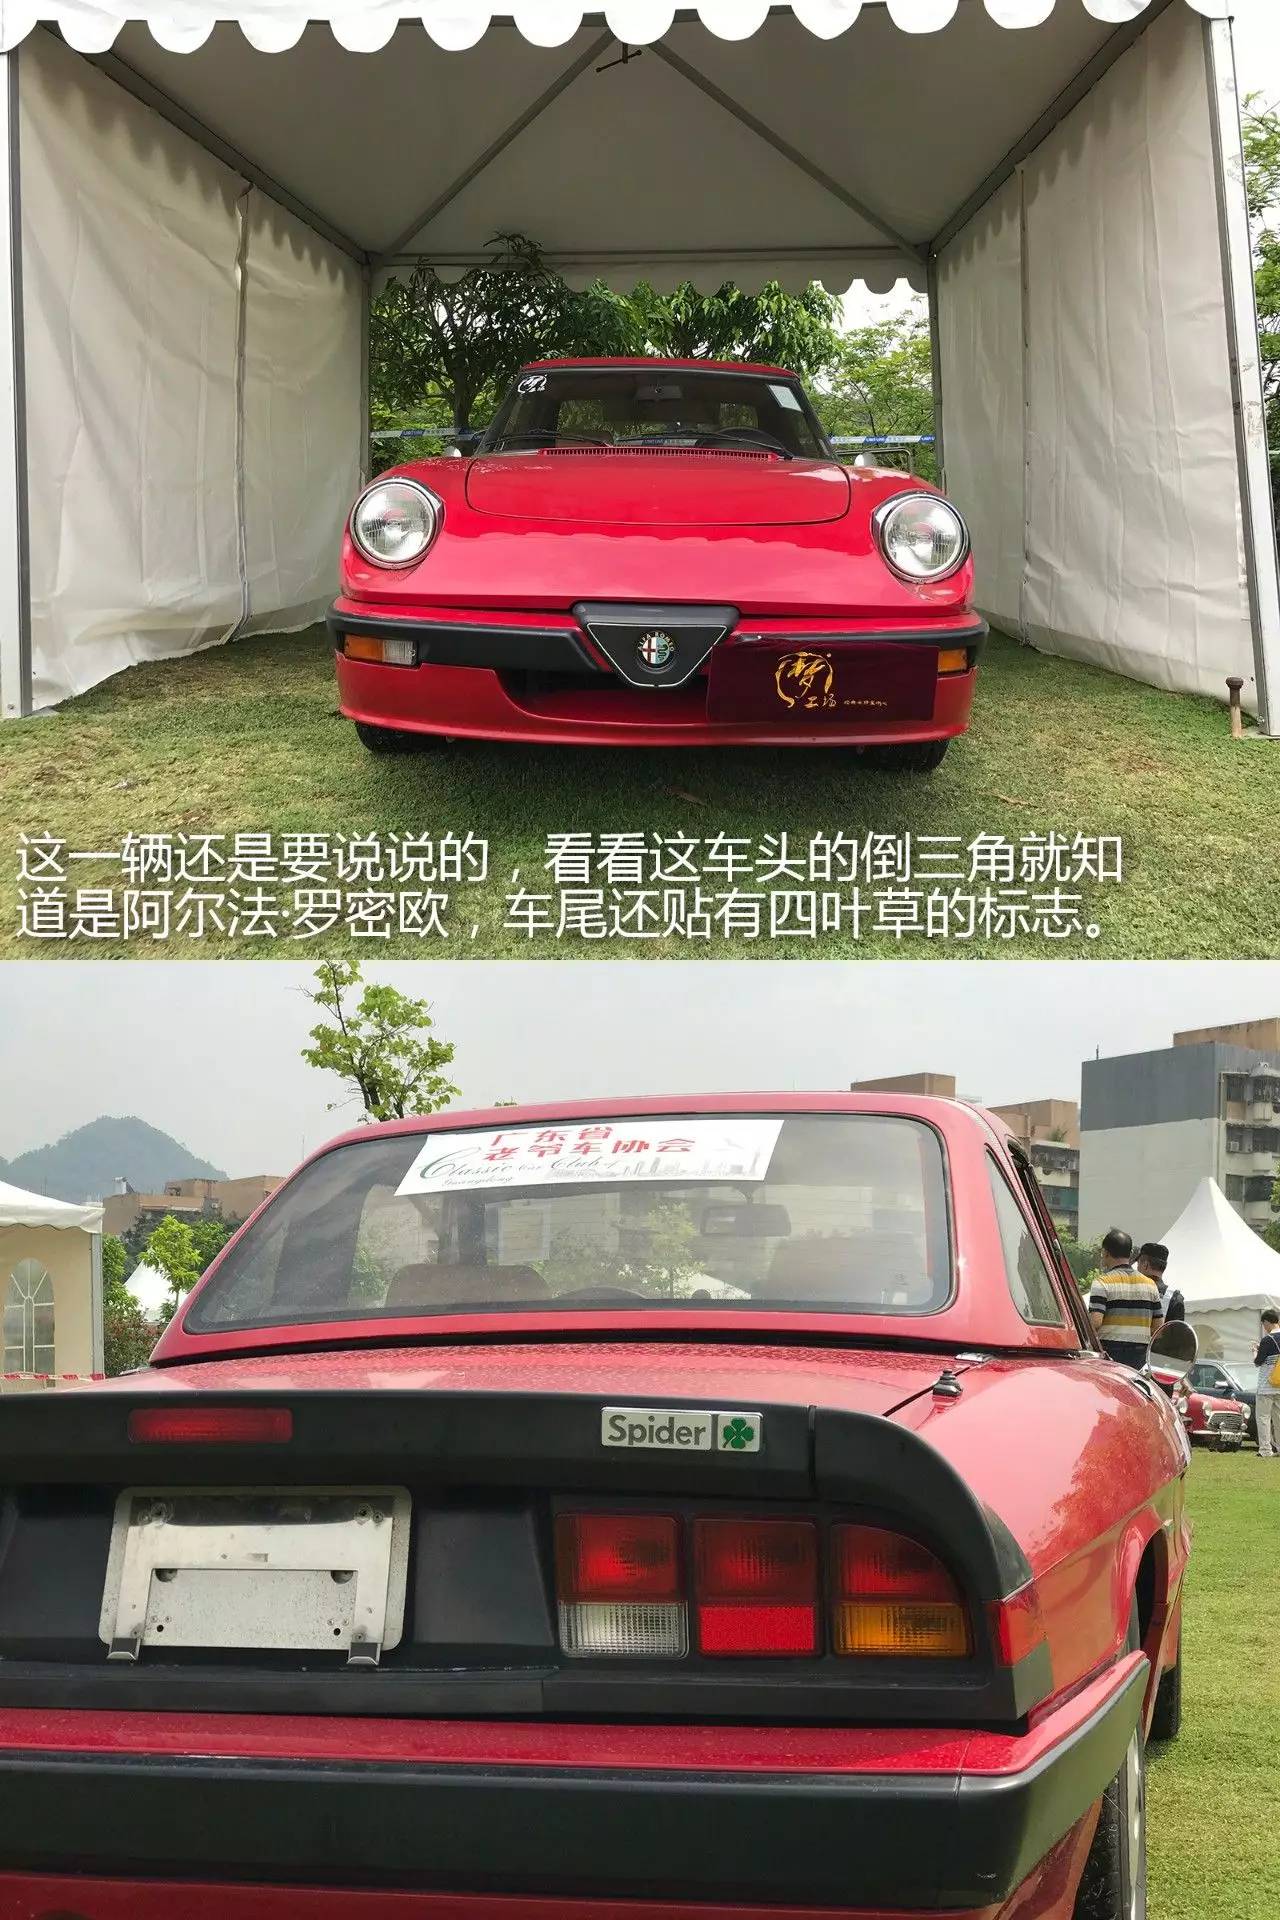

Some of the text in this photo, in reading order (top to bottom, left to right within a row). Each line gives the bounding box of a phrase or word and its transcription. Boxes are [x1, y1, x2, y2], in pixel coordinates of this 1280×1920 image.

[491, 1126, 614, 1147] 广东省
[483, 1138, 696, 1161] 老爷车协会
[608, 1414, 706, 1446] Spider
